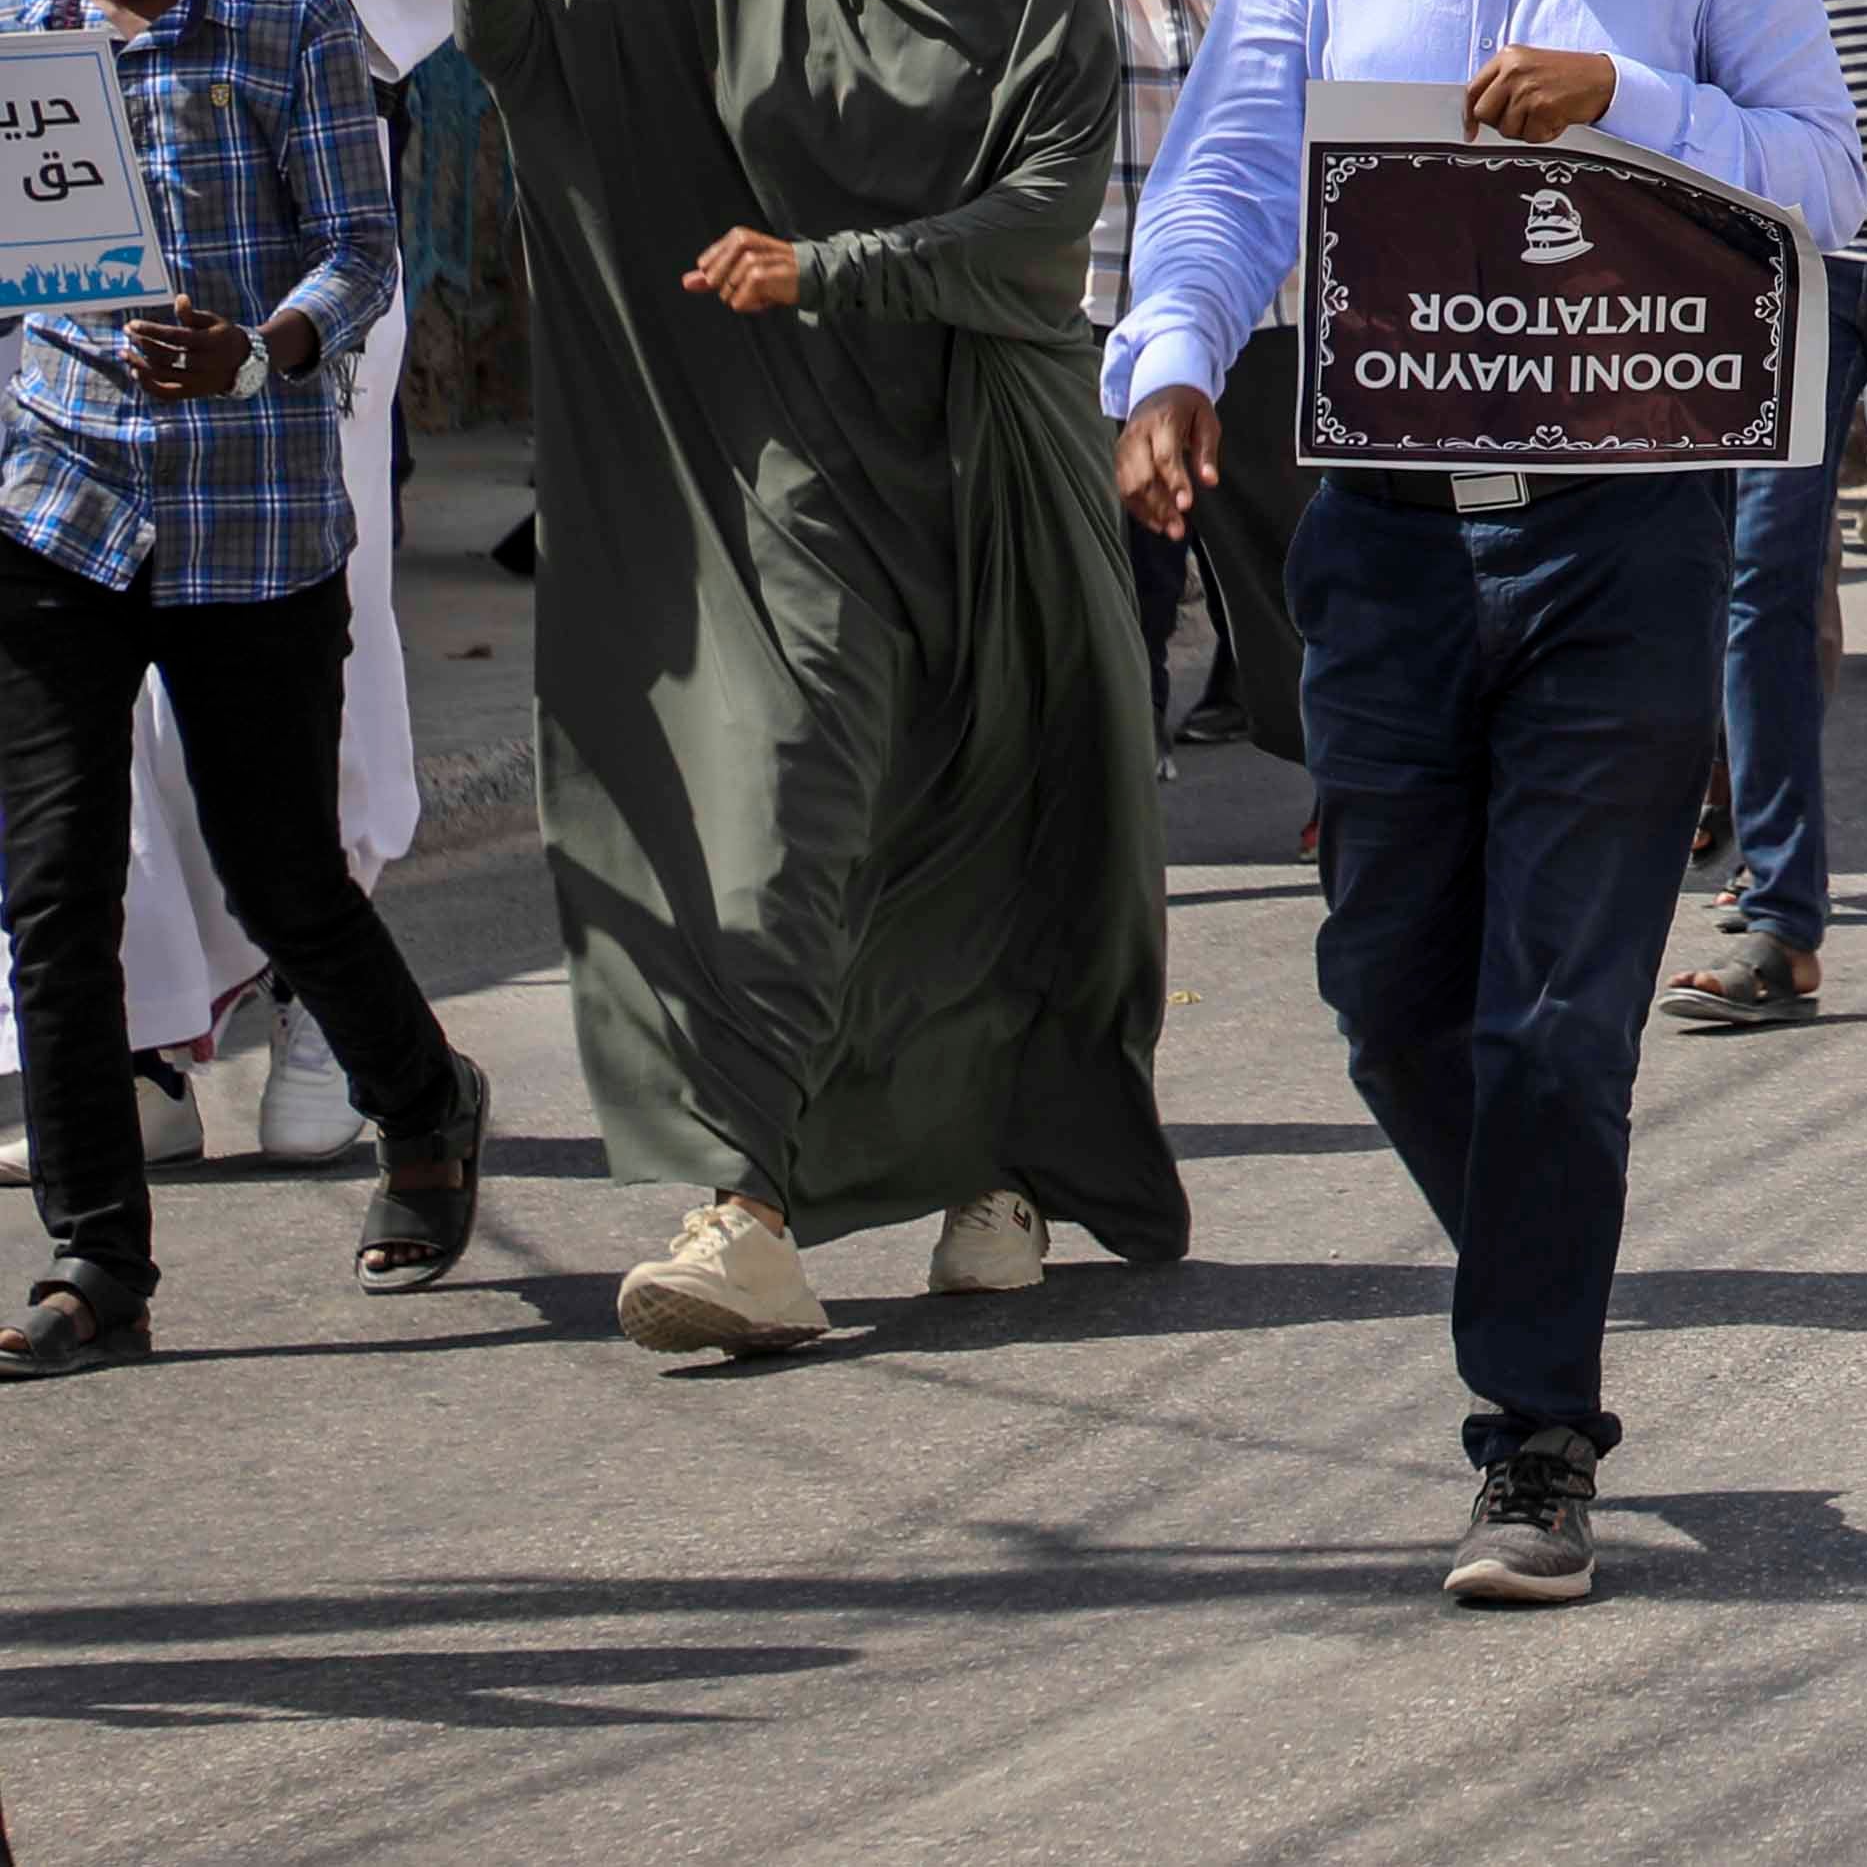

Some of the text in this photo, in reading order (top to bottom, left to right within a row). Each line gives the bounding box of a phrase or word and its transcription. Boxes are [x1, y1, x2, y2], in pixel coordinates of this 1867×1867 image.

[22, 151, 104, 202] حق
[1409, 292, 1707, 335] DIKTATOOR
[1354, 350, 1743, 393] DOONI MAYNO
